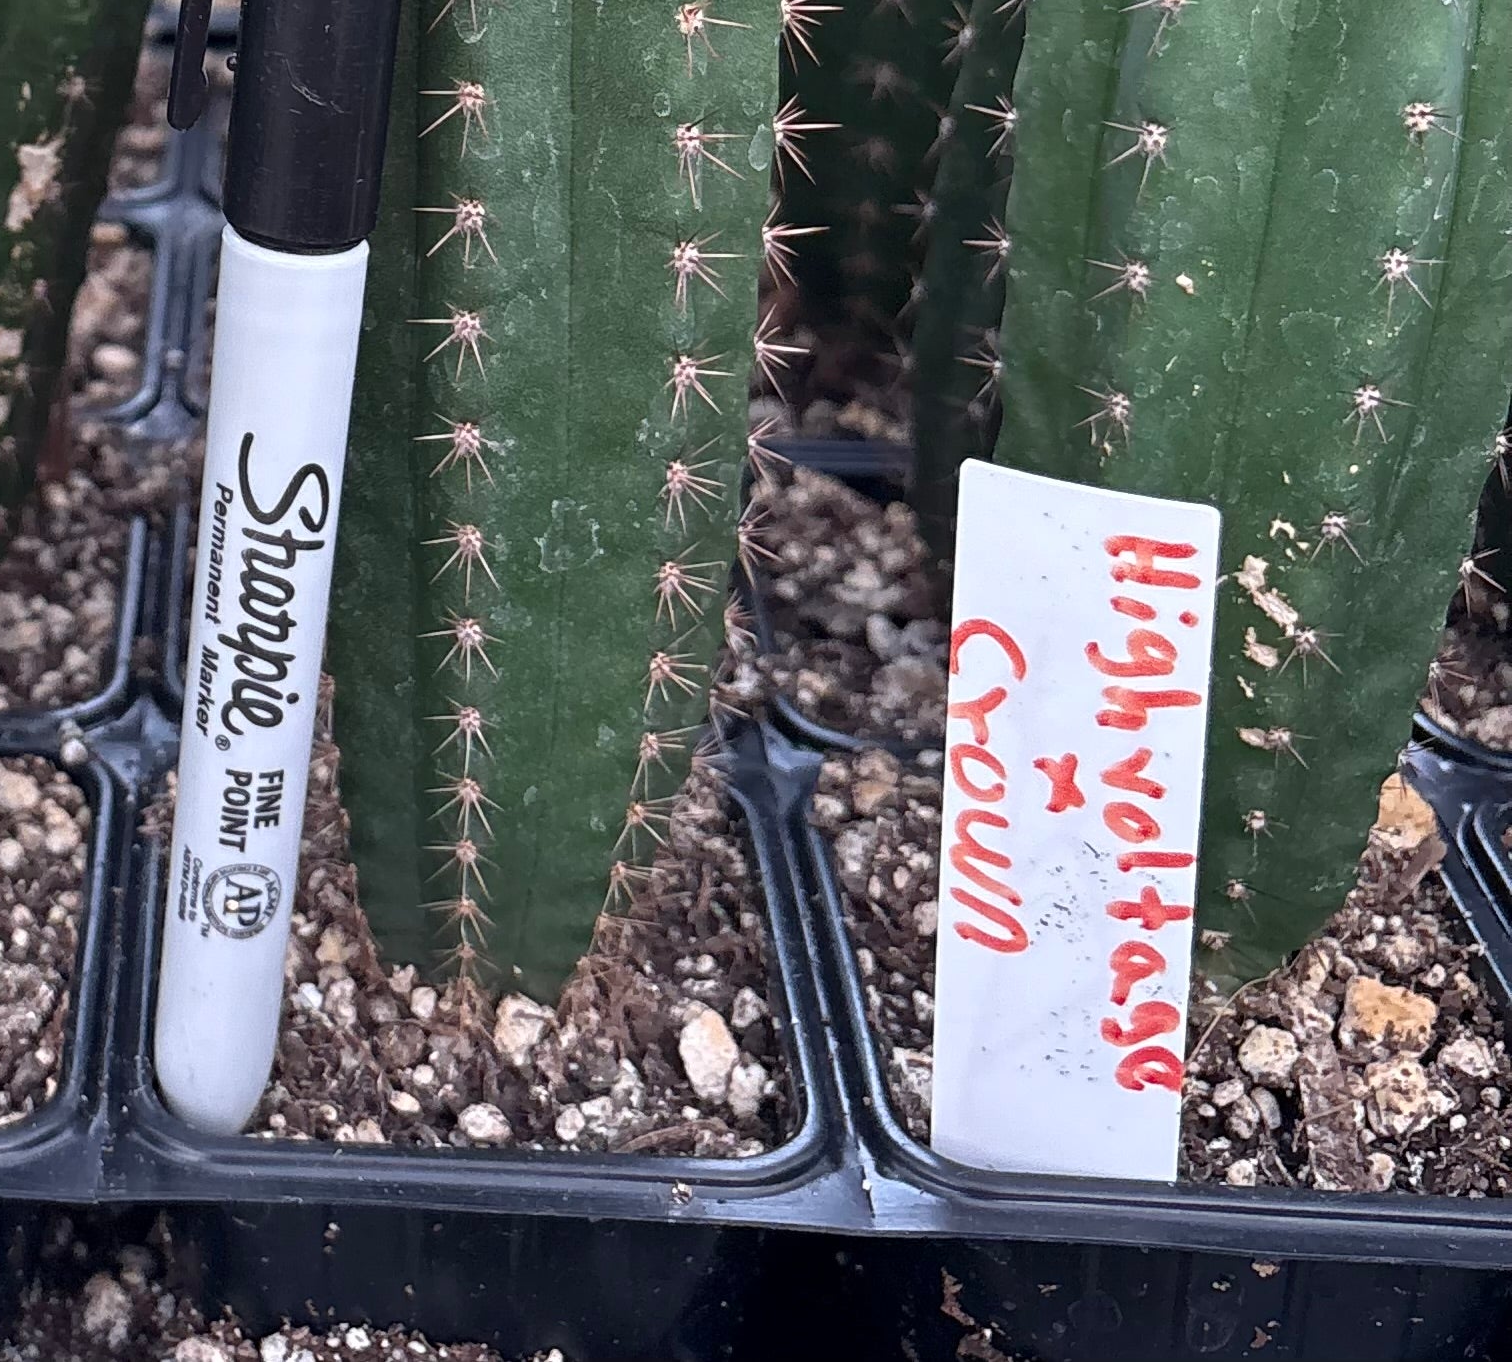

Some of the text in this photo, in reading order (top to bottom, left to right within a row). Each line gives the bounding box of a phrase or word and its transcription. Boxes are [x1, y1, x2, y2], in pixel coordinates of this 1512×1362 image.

[195, 482, 234, 738] Permanent Marker
[218, 432, 329, 736] Sharpie
[219, 769, 253, 853] POINT
[253, 769, 285, 829] FINE
[949, 619, 1029, 953] Crown
